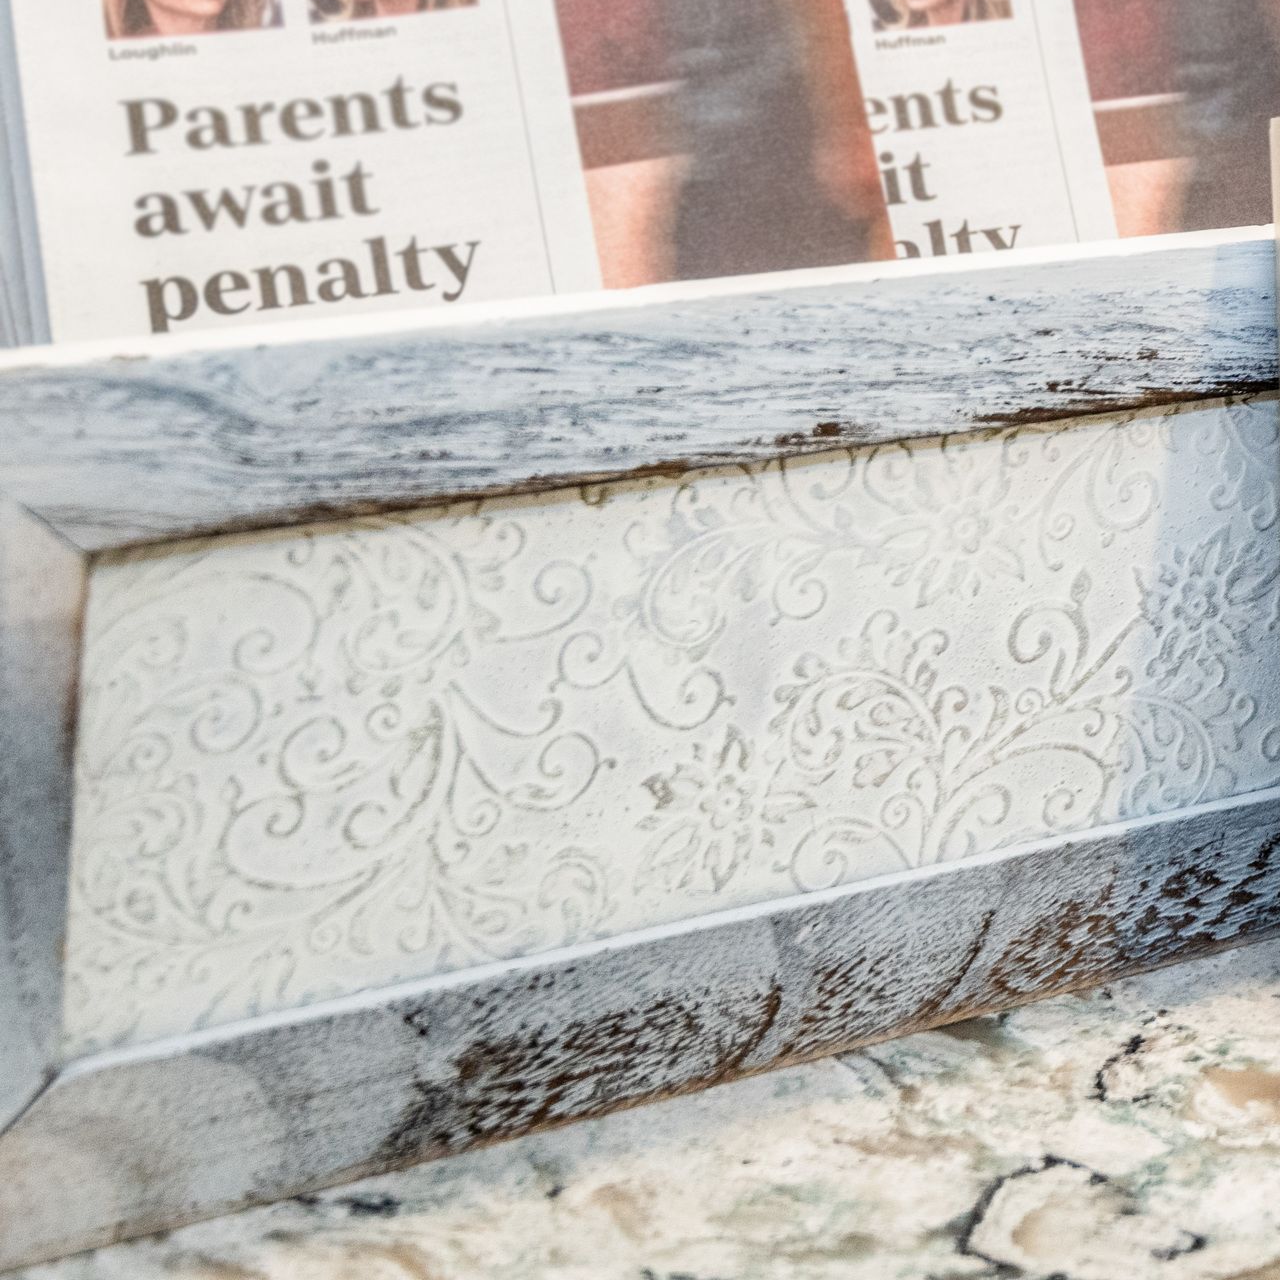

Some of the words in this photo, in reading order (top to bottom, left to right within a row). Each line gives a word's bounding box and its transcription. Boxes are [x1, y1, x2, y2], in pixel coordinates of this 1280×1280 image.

[108, 42, 198, 61] Loughlin
[311, 24, 398, 45] Huffman
[875, 33, 946, 51] Huffman
[119, 74, 464, 156] Parents
[134, 159, 380, 239] await
[138, 235, 481, 333] penalty
